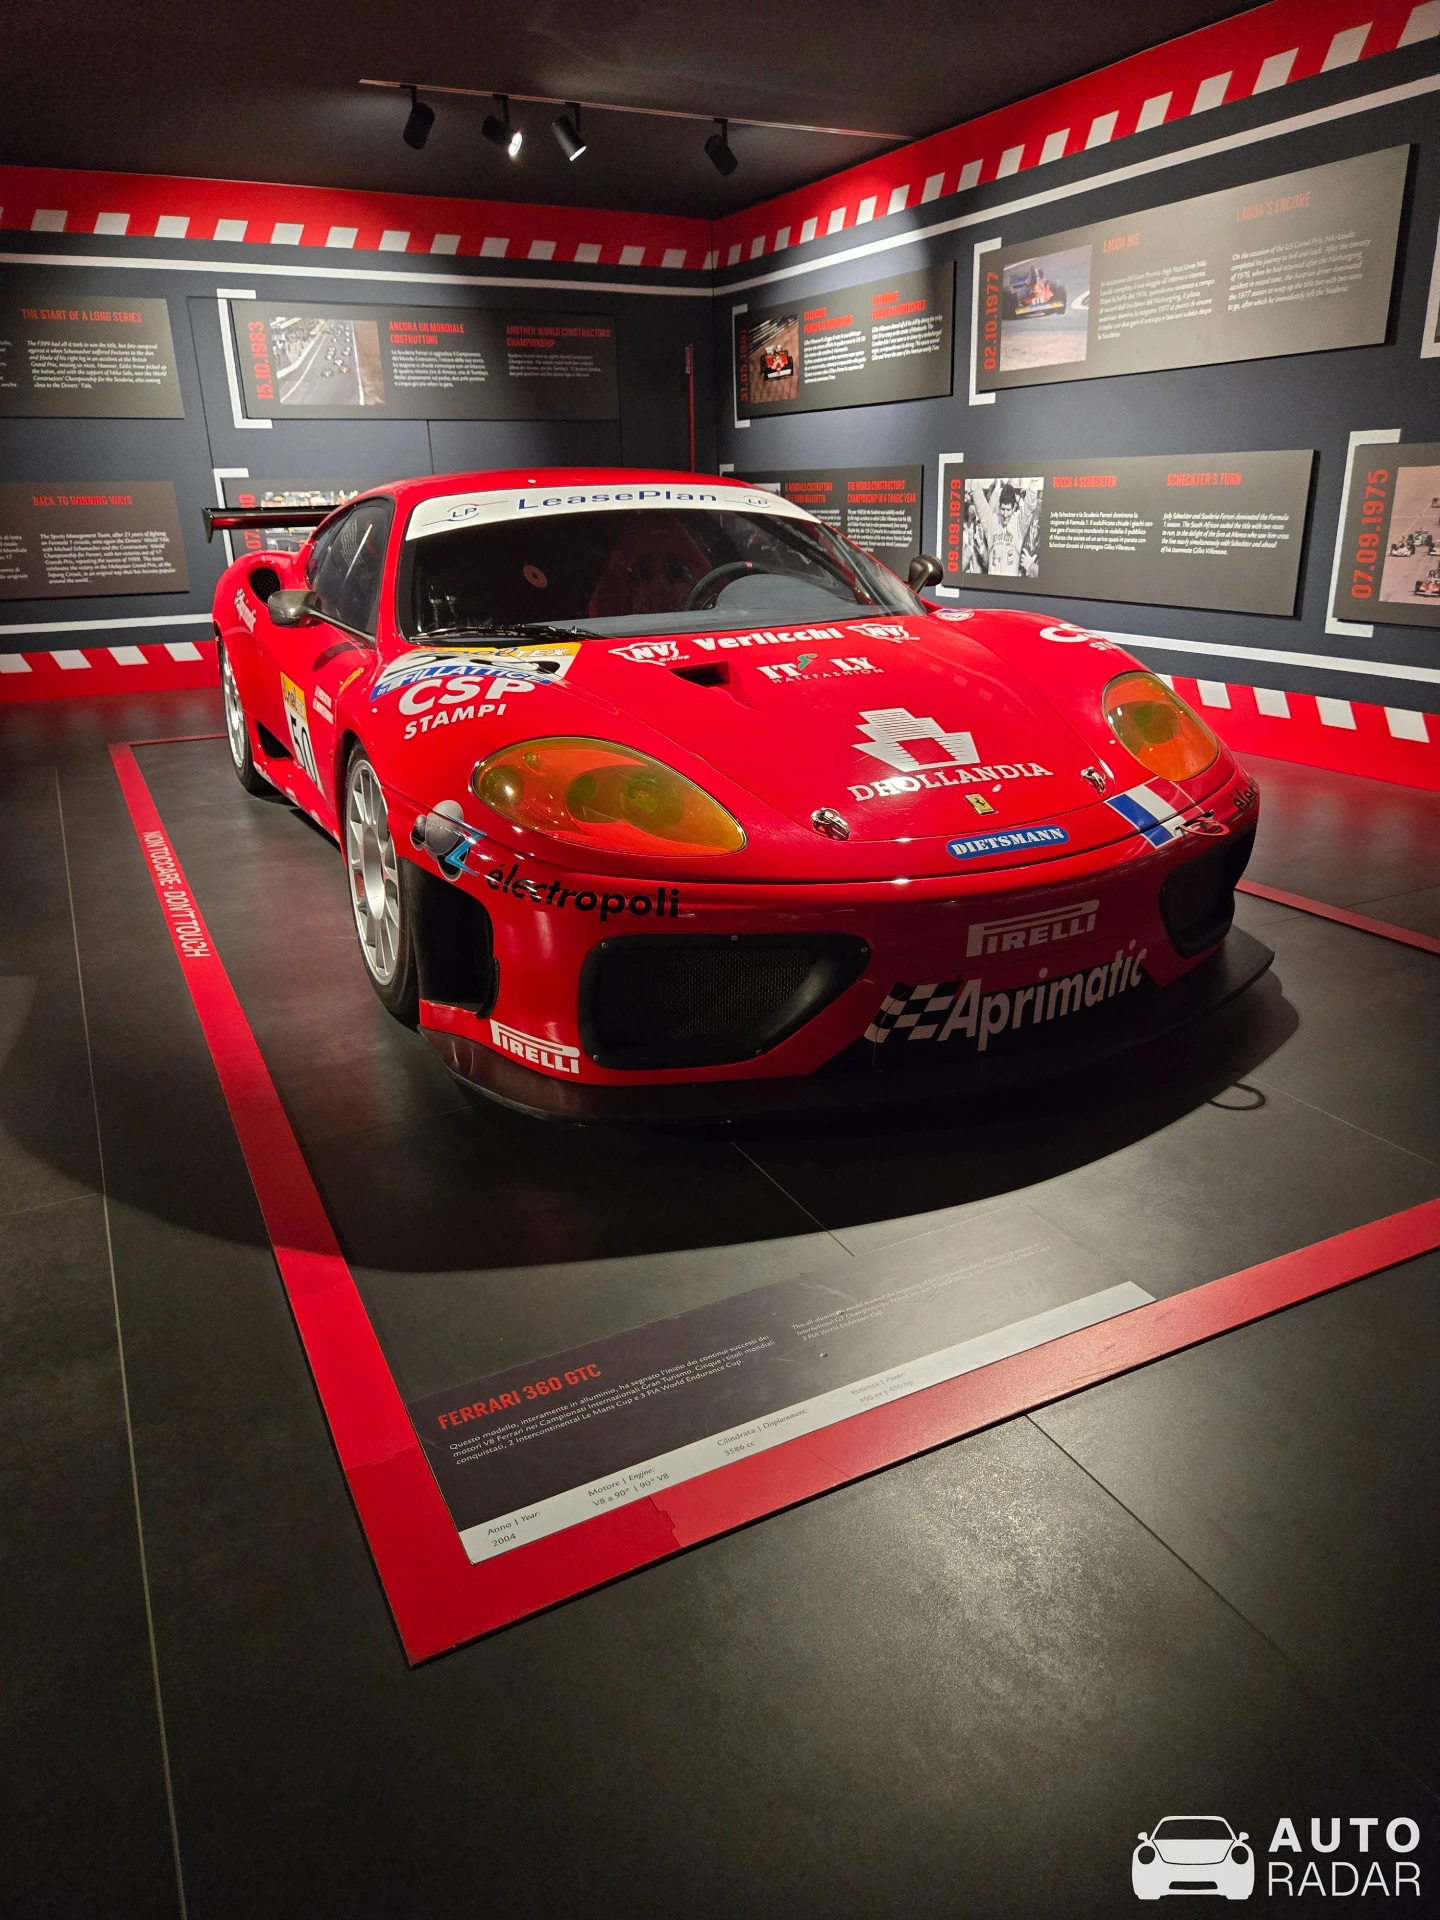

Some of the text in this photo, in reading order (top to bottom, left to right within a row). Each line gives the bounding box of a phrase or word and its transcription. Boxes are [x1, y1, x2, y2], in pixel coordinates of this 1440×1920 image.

[22, 309, 142, 323] THE START OF A LONG SERIES
[389, 321, 418, 332] ANCORA
[984, 271, 999, 370] 02.10.1977
[390, 334, 438, 345] COSTRUTTORI
[248, 321, 274, 400] 15.10.1983
[1167, 473, 1218, 486] SCHECKTER'S
[32, 496, 56, 506] BACK
[57, 496, 69, 506] TO
[451, 506, 477, 518] LP
[518, 490, 717, 510] LeasePlan
[947, 479, 962, 572] 09.09.1979
[1351, 469, 1389, 598] 07.09.1975
[630, 644, 673, 660] NV
[692, 628, 845, 651] Verlicchi
[659, 653, 690, 663] Group
[772, 667, 884, 685] HAIRFASHION
[398, 676, 536, 716] CSP
[404, 704, 506, 740] STAMPI
[846, 762, 1054, 802] DHOLLANDIA
[951, 828, 1066, 856] DIETSMANN
[143, 831, 211, 957] NON TOCCARE DON'T TOUCH
[485, 863, 680, 922] électropoli
[965, 899, 1100, 958] PIRELLI
[937, 939, 1147, 1052] Aprimatic
[490, 1019, 580, 1074] PIRELLI
[438, 1364, 601, 1430] FERRARI 360 GTC
[450, 1436, 480, 1450] Questo
[483, 1422, 519, 1438] modello,
[520, 1405, 569, 1425] interamente
[580, 1388, 619, 1404] alluminio,
[619, 1382, 629, 1390] ha
[631, 1373, 660, 1385] segnato
[687, 1359, 698, 1367] dei
[700, 1349, 728, 1362] continui
[729, 1340, 757, 1351] successi
[453, 1444, 481, 1457] motori
[484, 1438, 495, 1446] V8
[497, 1427, 524, 1442] Ferrari
[526, 1424, 538, 1433] nei
[540, 1406, 587, 1427] Campionati
[588, 1388, 640, 1408] Internazionali
[641, 1380, 660, 1390] Gran
[660, 1369, 694, 1383] Turismo.
[695, 1359, 721, 1371] Cinque
[744, 1340, 775, 1354] mondiali
[851, 1381, 880, 1396] Potenza
[456, 1444, 507, 1465] conquistati,
[516, 1415, 581, 1443] Intercontinental
[593, 1404, 615, 1416] Mans
[616, 1398, 632, 1407] Cup
[647, 1388, 661, 1397] FIA
[660, 1379, 685, 1391] World
[686, 1366, 725, 1382] Endurance
[717, 1408, 808, 1446] Cilindrata Displacement:
[724, 1444, 745, 1457] 3586
[588, 1467, 655, 1497] Motore Engine:
[593, 1498, 606, 1507] V8
[615, 1488, 629, 1499] 90°
[640, 1478, 654, 1489] 90°
[657, 1473, 669, 1482] V8
[487, 1510, 541, 1536] Anno Year:
[492, 1533, 516, 1547] 2004
